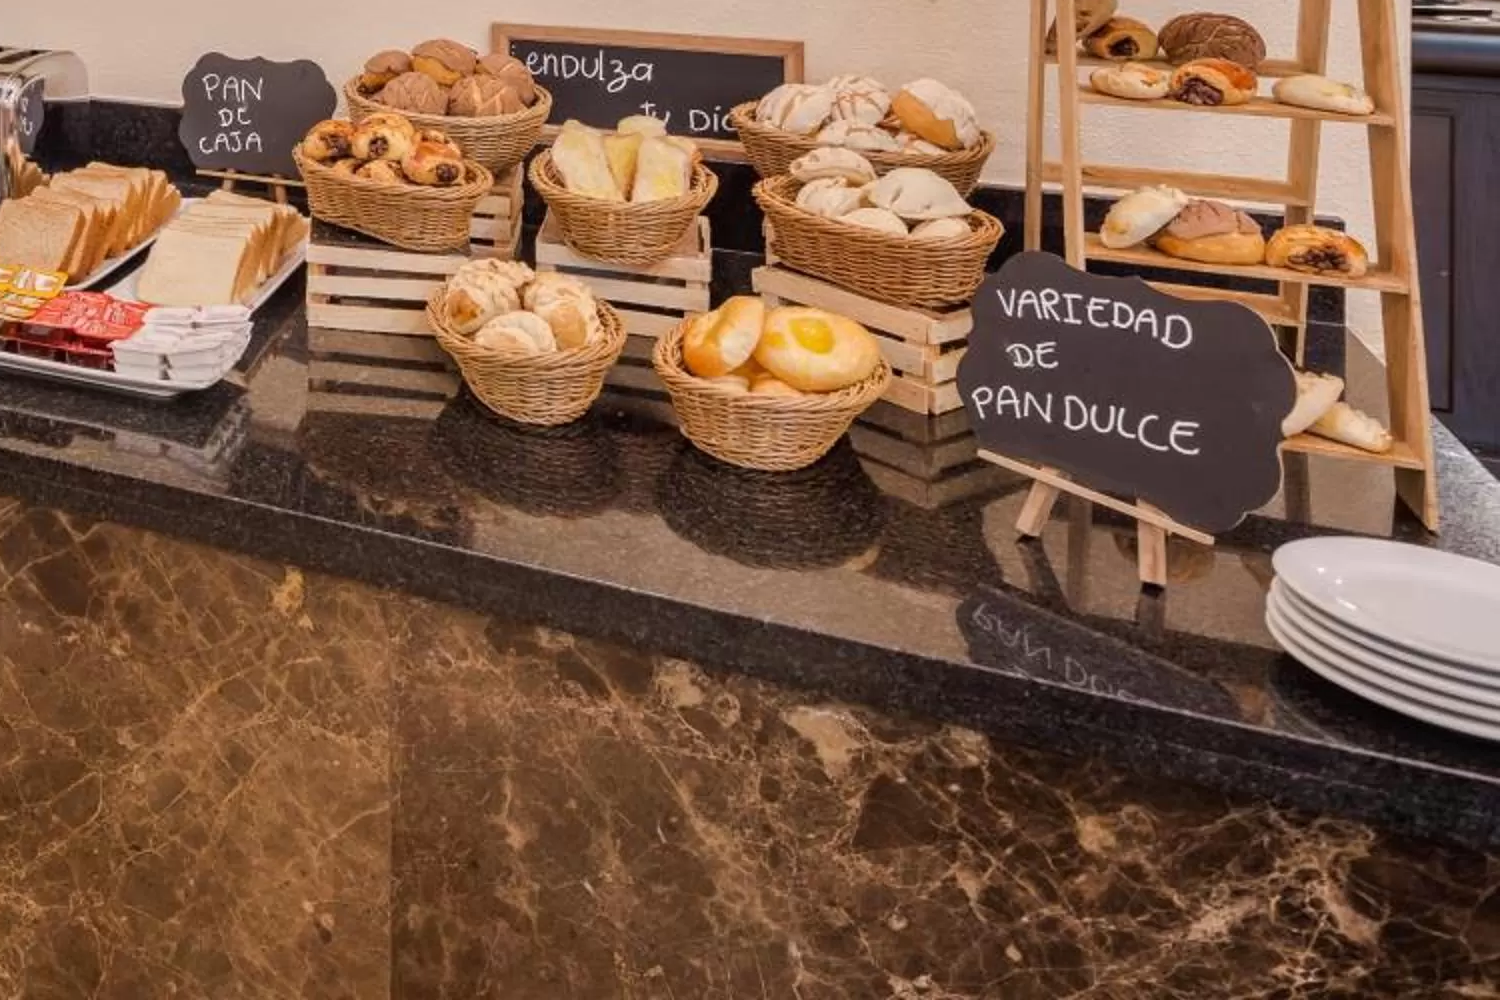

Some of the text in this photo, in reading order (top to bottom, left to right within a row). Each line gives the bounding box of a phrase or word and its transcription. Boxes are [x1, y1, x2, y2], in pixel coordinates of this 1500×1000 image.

[202, 73, 264, 102] PAN
[199, 130, 263, 155] CAJA
[996, 287, 1194, 350] VARIEDAD
[1005, 341, 1060, 369] DE
[971, 385, 1201, 456] PAN DULCE
